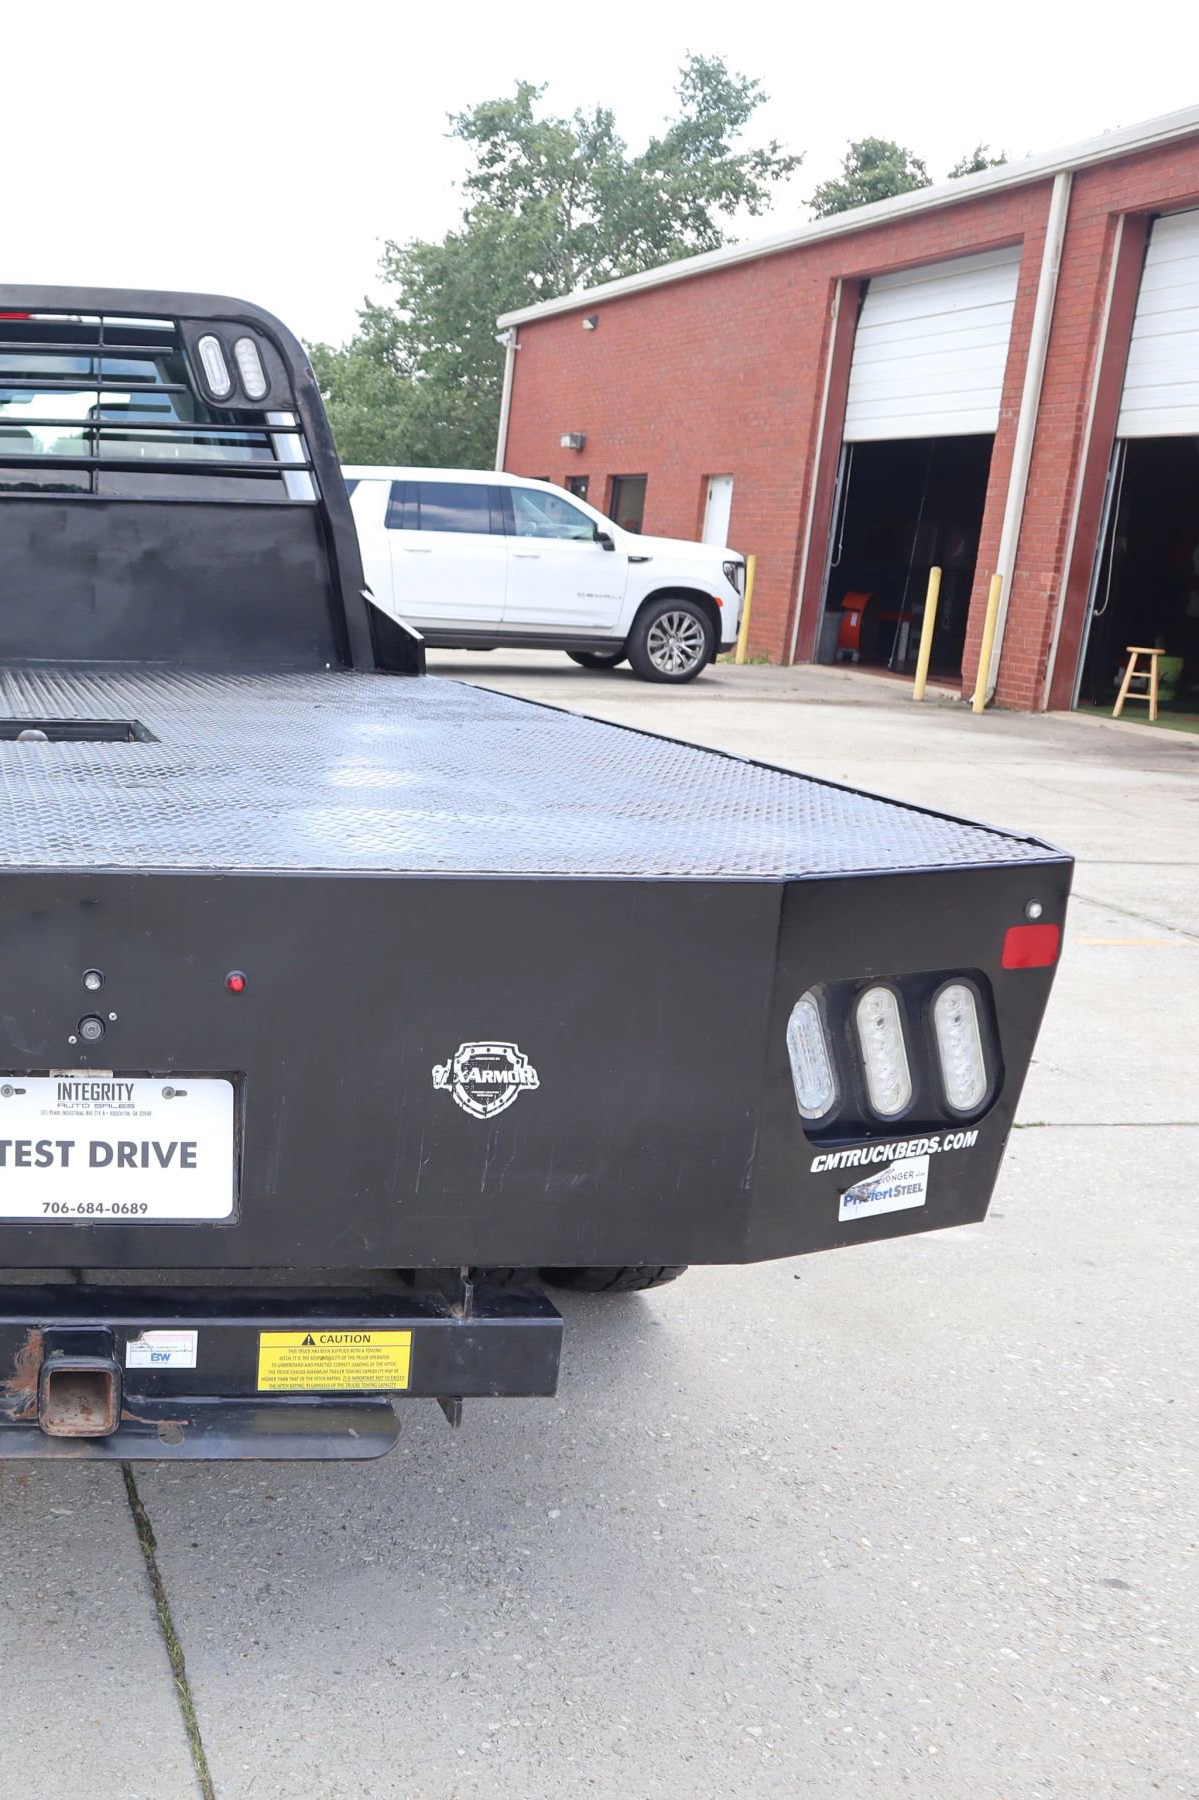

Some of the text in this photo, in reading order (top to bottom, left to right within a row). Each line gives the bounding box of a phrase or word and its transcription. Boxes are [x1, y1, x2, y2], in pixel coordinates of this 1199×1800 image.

[58, 1082, 134, 1101] INTEGRITY
[88, 1140, 197, 1169] DRIVE
[810, 1130, 979, 1173] CMTRUCKBEDS.COM
[42, 1202, 148, 1214] 706-684-0689
[320, 1334, 371, 1344] CAUTION
